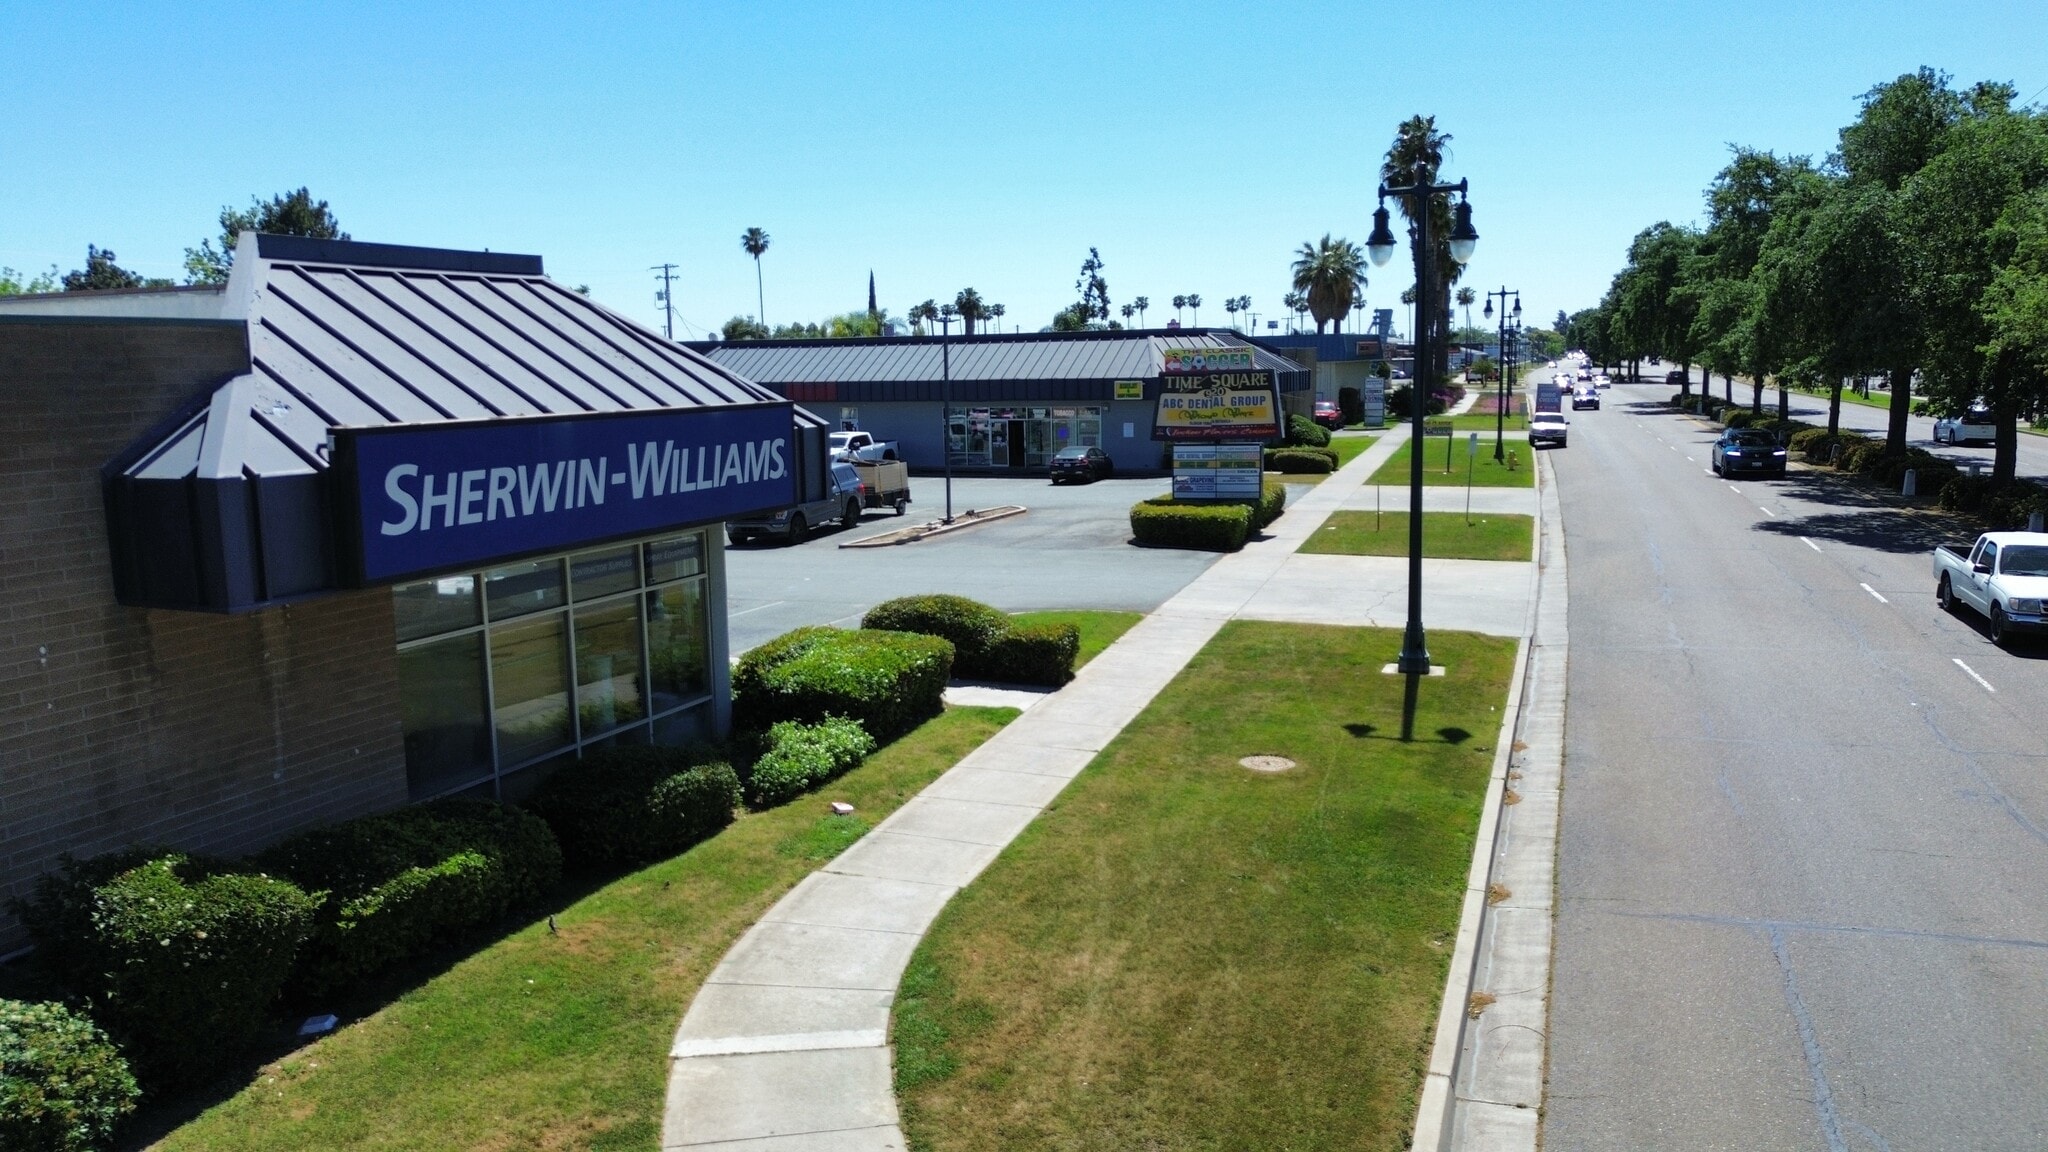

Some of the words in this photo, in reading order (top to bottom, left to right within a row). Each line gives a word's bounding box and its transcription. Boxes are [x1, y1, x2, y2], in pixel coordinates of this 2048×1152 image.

[1181, 354, 1251, 371] SOCCER
[1165, 376, 1203, 392] TIME
[1210, 373, 1269, 389] SQUARE
[1205, 388, 1225, 397] 920
[1163, 398, 1183, 408] ABC
[1188, 397, 1226, 409] DENTAL
[1231, 396, 1266, 407] GROUP
[381, 438, 786, 536] SHERWIN-WILLIAMS
